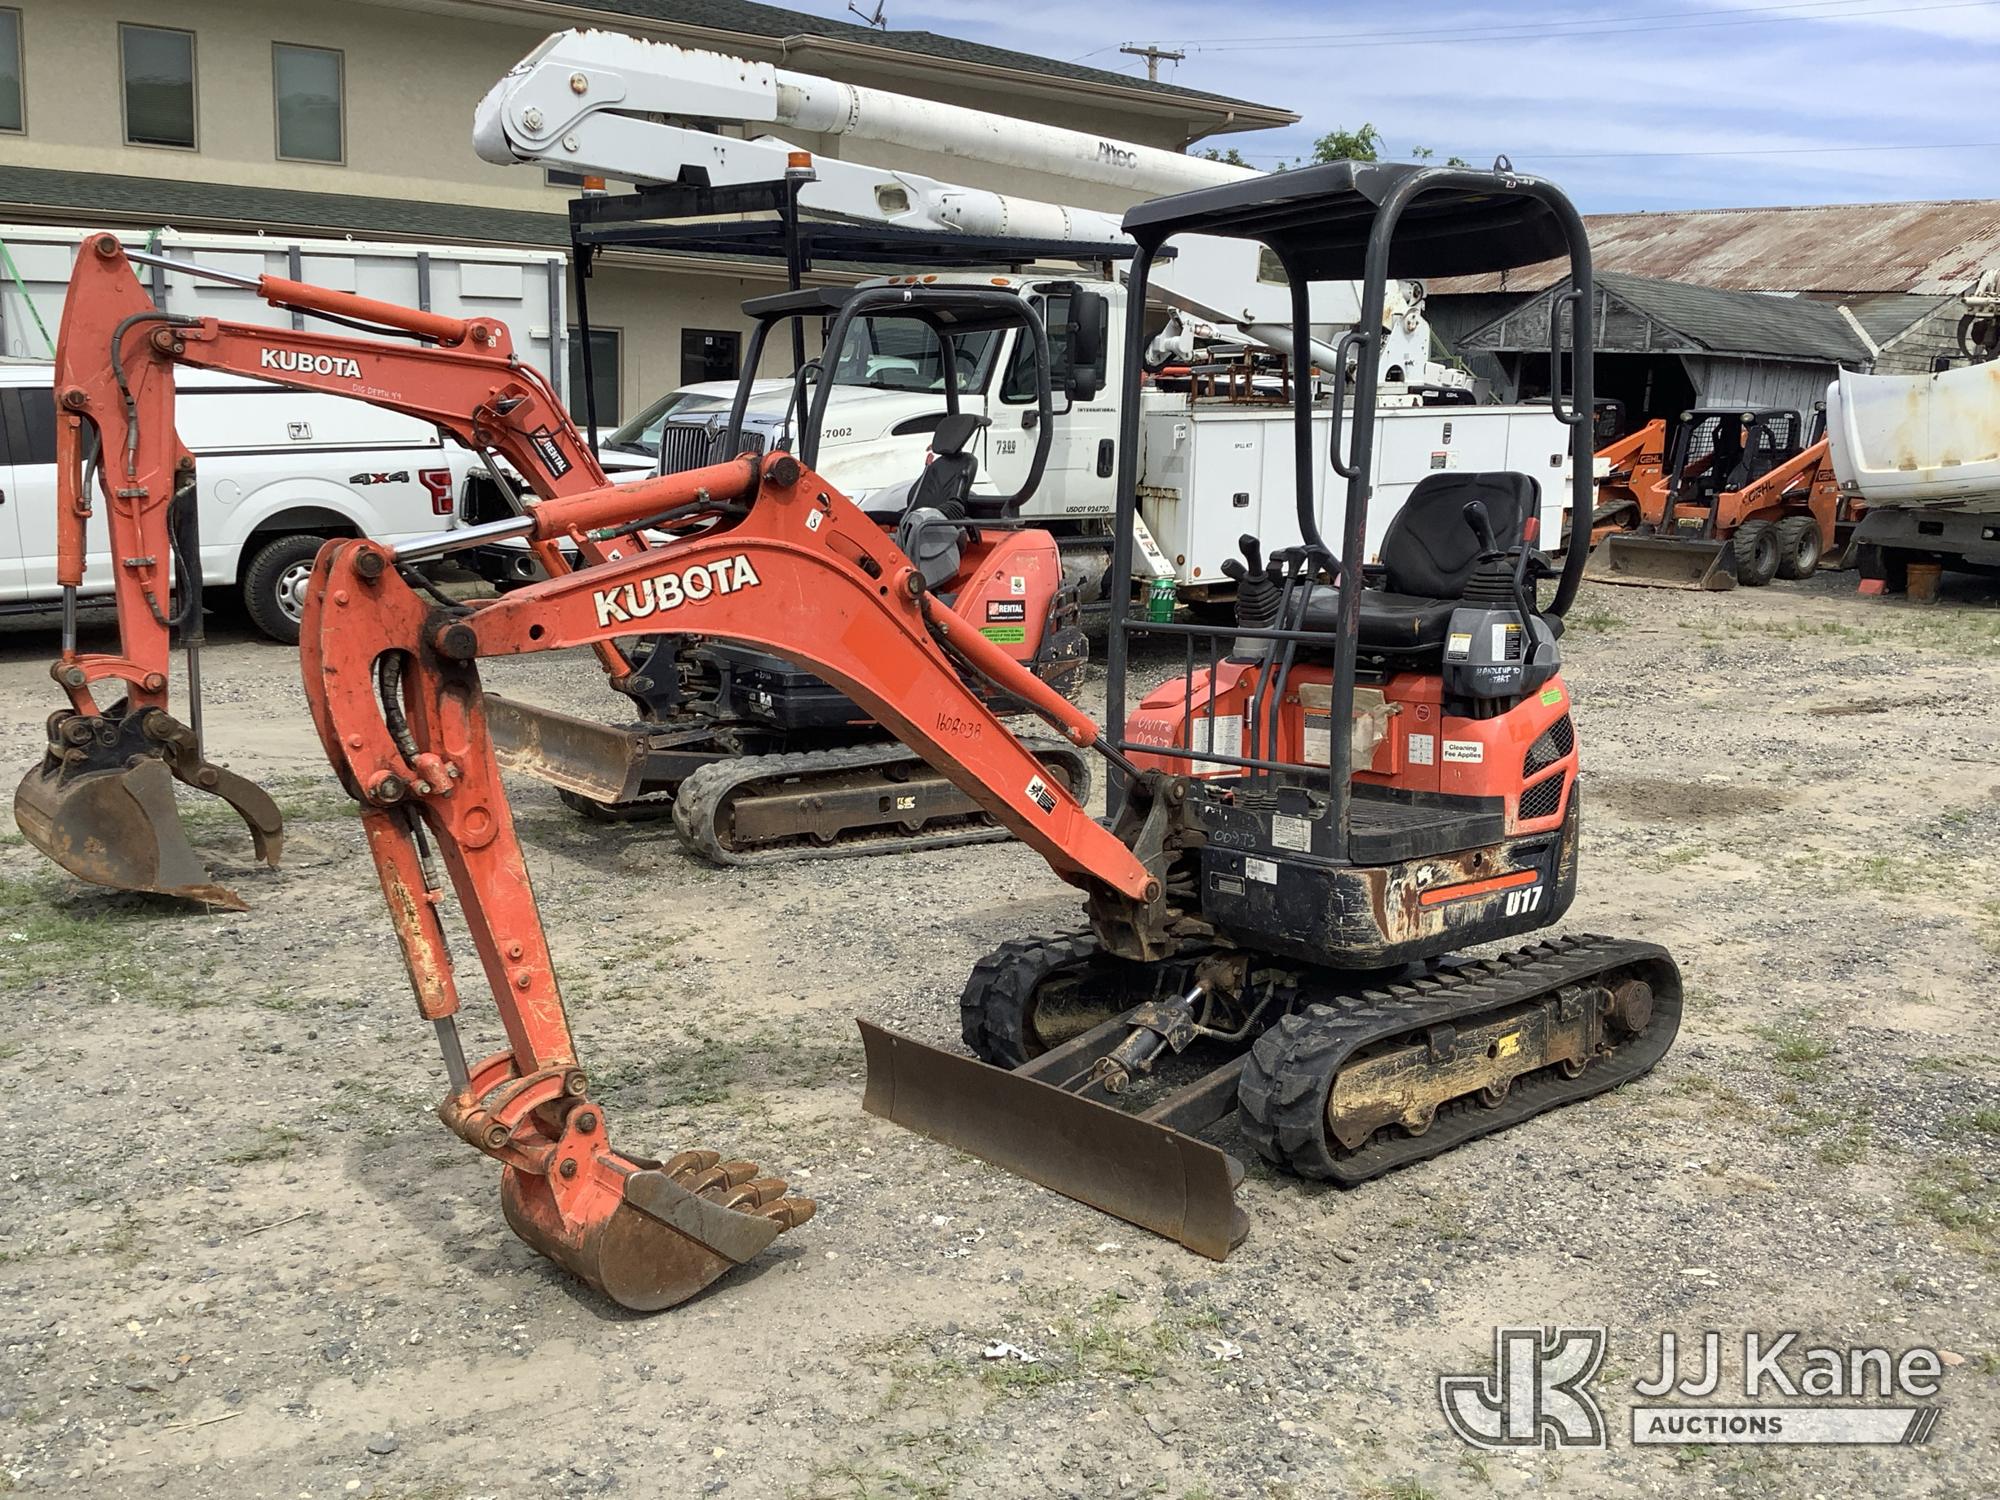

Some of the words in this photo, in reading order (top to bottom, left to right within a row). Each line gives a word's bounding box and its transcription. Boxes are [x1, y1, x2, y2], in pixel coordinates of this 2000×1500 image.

[1095, 141, 1137, 169] Altec
[260, 348, 363, 379] KUBOTA
[543, 440, 567, 472] RENTAL
[996, 440, 1016, 455] 7300
[1639, 455, 1662, 464] GEHL
[1748, 482, 1775, 502] GEHL
[1066, 505, 1087, 513] USDOT
[1087, 505, 1110, 513] 924720
[592, 553, 761, 628] KUBOTA
[998, 604, 1024, 613] RENTAL
[1138, 716, 1169, 732] UNIT
[1448, 744, 1478, 752] Cleaning
[1505, 885, 1544, 917] U17
